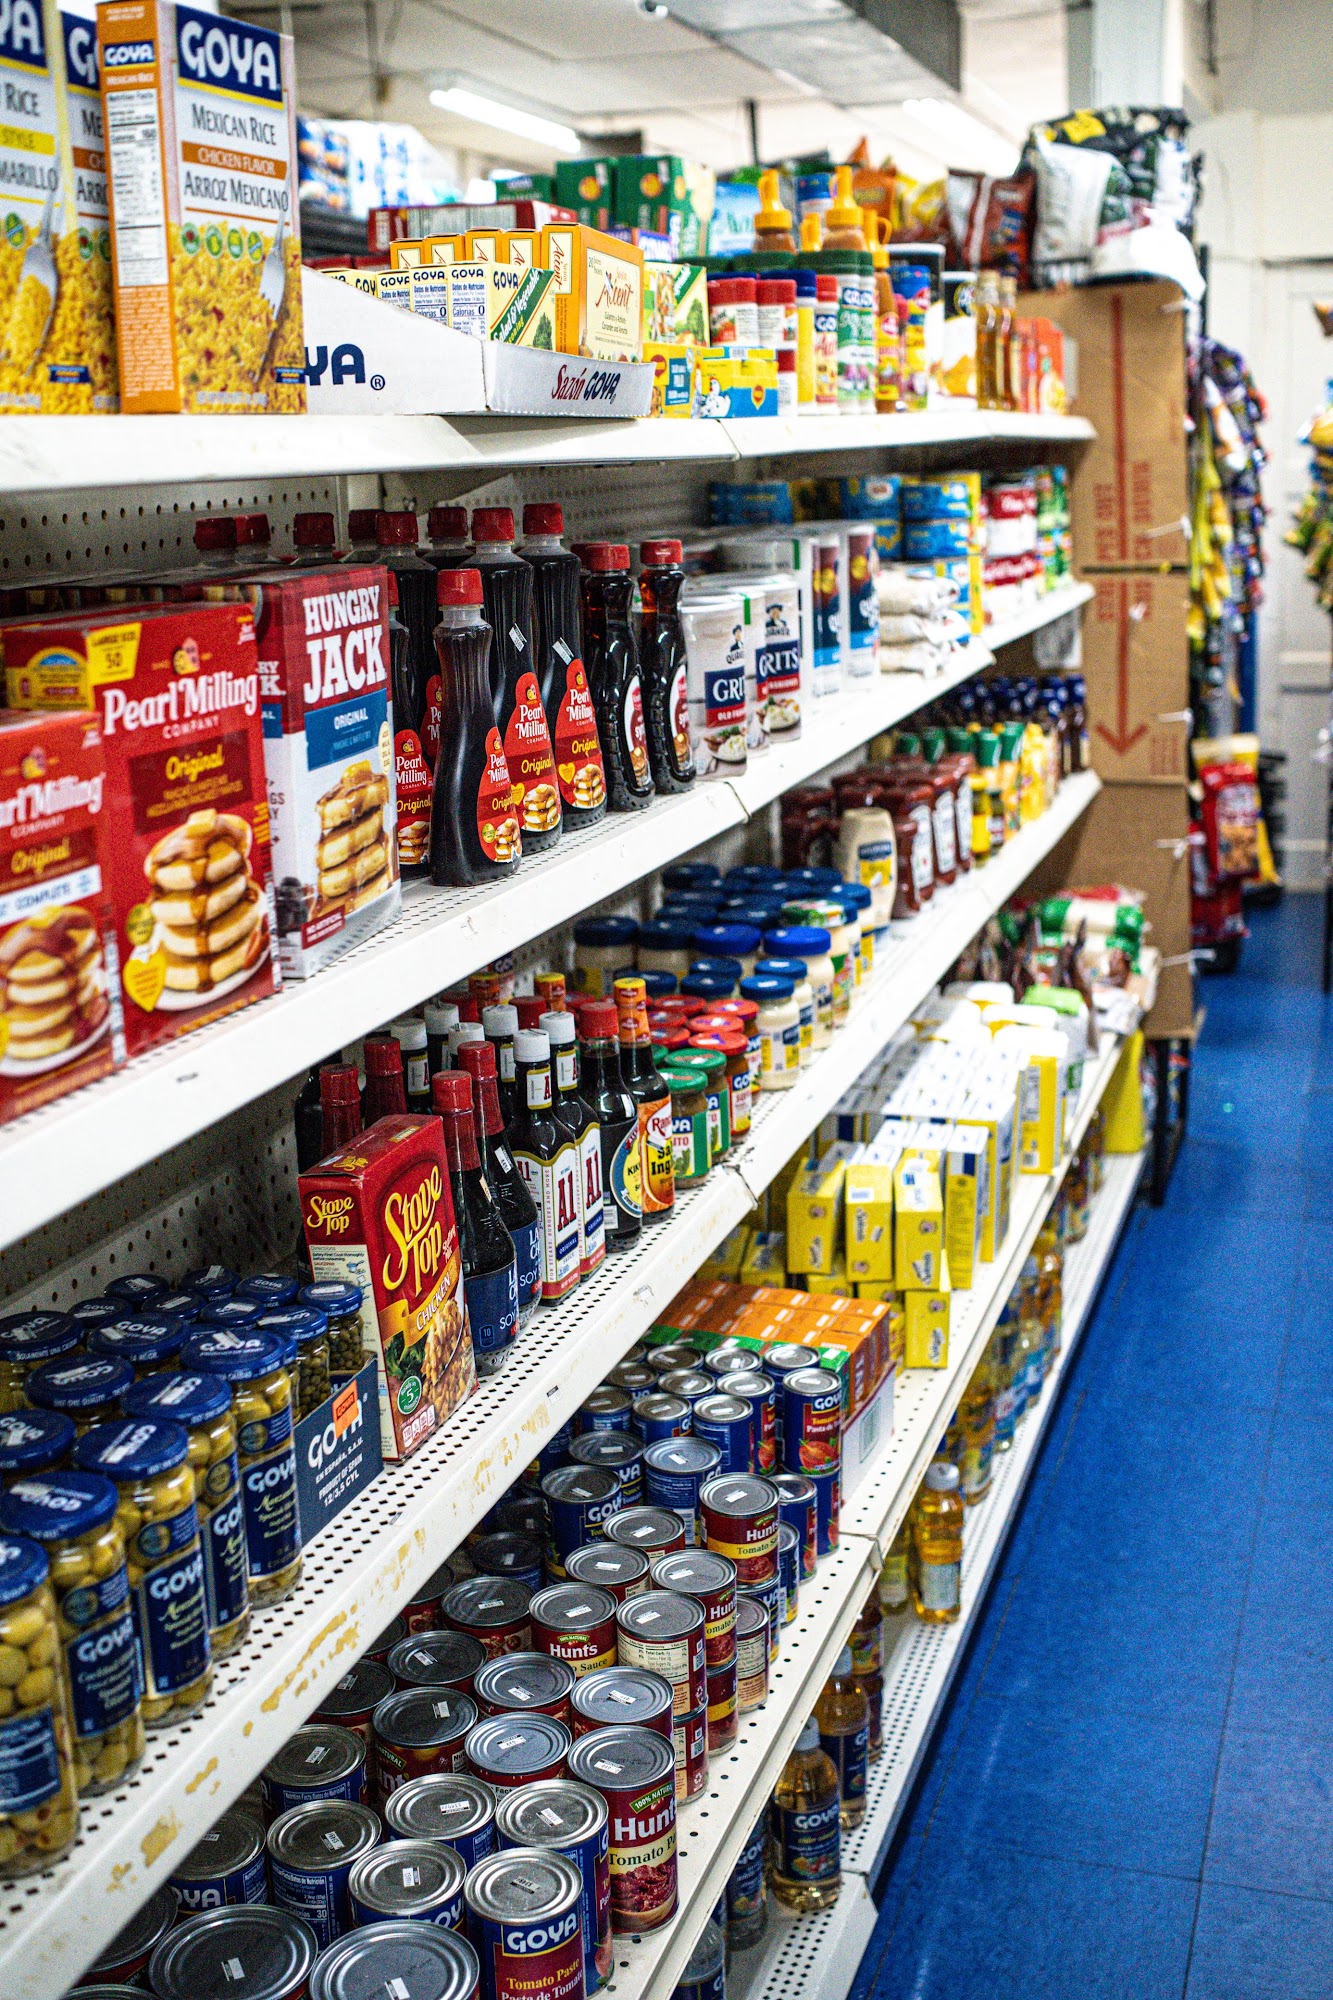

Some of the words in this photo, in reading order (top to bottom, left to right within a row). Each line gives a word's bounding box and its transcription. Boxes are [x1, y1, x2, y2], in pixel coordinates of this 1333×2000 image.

[104, 43, 154, 65] GOYA
[180, 20, 278, 91] GOYA
[5, 82, 40, 117] RICE
[250, 116, 277, 146] RICE
[197, 147, 241, 168] CHICKEN
[242, 154, 276, 176] FLAVOR
[184, 171, 226, 201] ARROZ
[414, 270, 446, 282] GOYA
[452, 268, 485, 280] GOYA
[494, 271, 519, 291] GOYA
[440, 306, 447, 318] 0
[479, 305, 486, 317] 0
[552, 364, 586, 401] Sazón
[584, 371, 621, 402] GOYA
[303, 585, 380, 636] HUNGRY
[303, 625, 388, 704] JACK
[103, 681, 179, 736] Pearl
[178, 671, 258, 716] Milling
[570, 688, 590, 705] Pearl
[334, 708, 369, 730] ORIGINAL
[520, 703, 543, 722] Pearl
[566, 704, 595, 721] Milling
[515, 721, 548, 740] Milling
[572, 737, 598, 756] Original
[166, 744, 225, 782] Original
[396, 755, 423, 771] Pearl
[521, 755, 552, 775] Original
[396, 769, 428, 786] Milling
[397, 795, 432, 814] Original
[307, 1196, 355, 1229] Stove
[323, 1214, 350, 1236] Top
[383, 1165, 443, 1291] Stove
[559, 1237, 578, 1256] ORIGINAL
[406, 1221, 443, 1298] Top
[519, 1268, 538, 1287] SOY
[415, 1270, 451, 1330] CHICKEN
[116, 1320, 168, 1336] GOYA
[499, 1313, 516, 1331] SOY
[483, 1328, 492, 1338] 10
[406, 1389, 415, 1402] 5
[315, 1473, 324, 1485] EN
[318, 1475, 341, 1500] PRODUCT
[340, 1467, 349, 1480] OF
[347, 1452, 363, 1473] SPAIN
[345, 1469, 360, 1488] CYL
[569, 1634, 589, 1642] NATURAL
[580, 1658, 608, 1672] Sauce
[634, 1795, 651, 1810] 100%
[609, 1846, 665, 1867] Tomato
[316, 1909, 328, 1920] 30
[507, 1913, 577, 1953] GOYA
[506, 1974, 555, 1991] Tomato
[556, 1957, 580, 1981] Paste
[551, 1968, 584, 1999] Tomate
